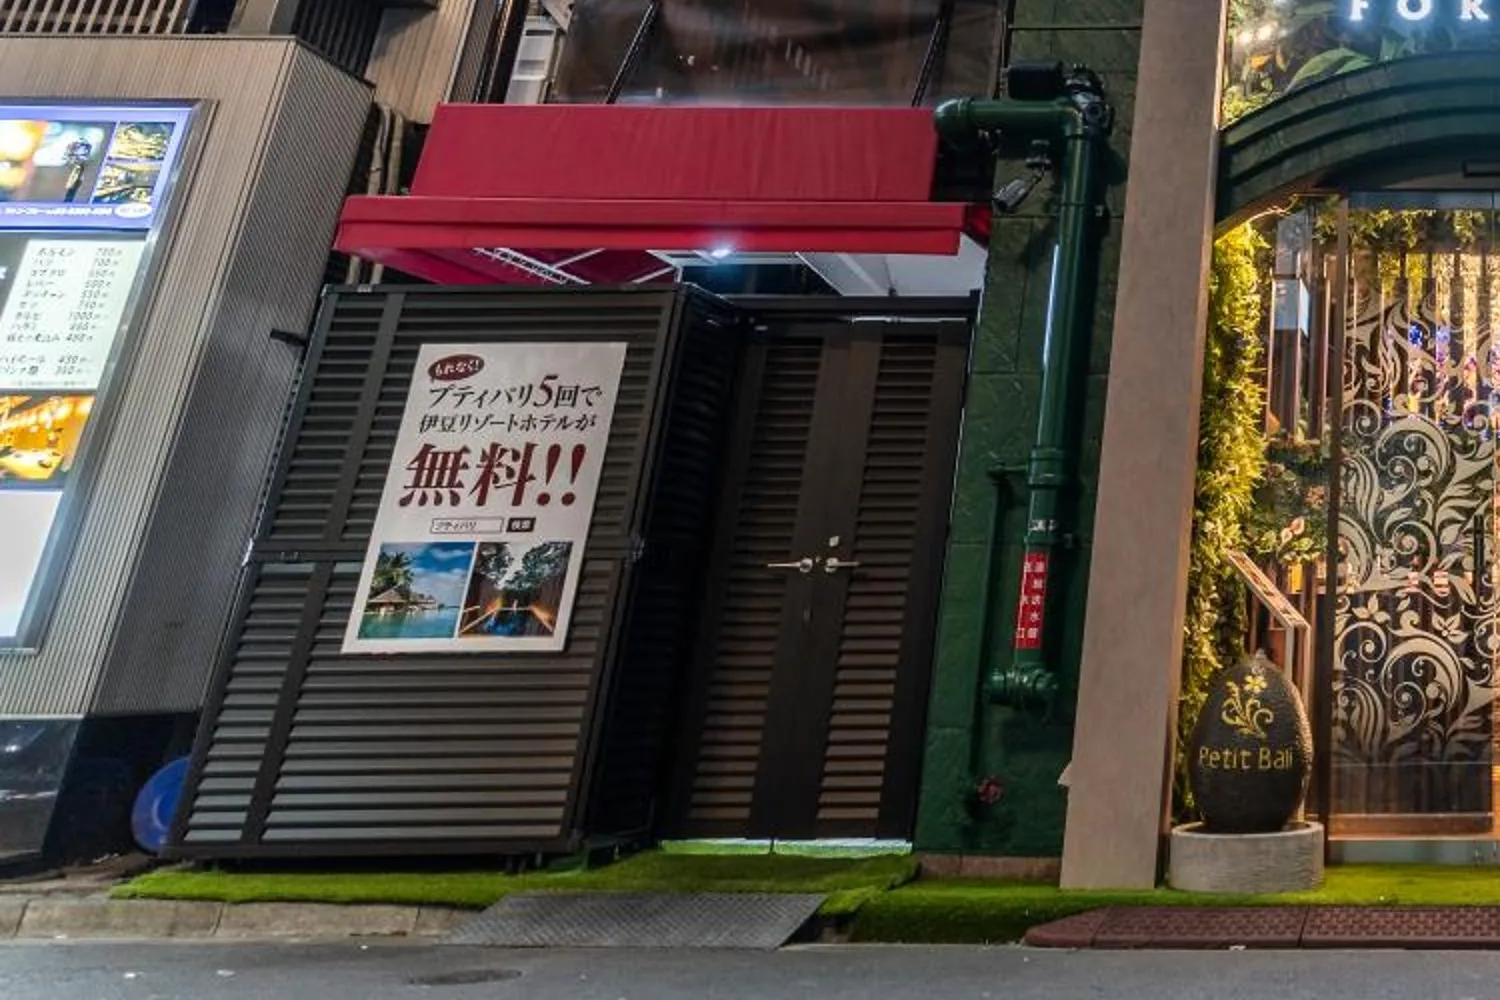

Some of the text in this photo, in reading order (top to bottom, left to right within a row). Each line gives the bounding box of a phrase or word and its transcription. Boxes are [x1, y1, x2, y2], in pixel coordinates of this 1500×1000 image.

[420, 412, 597, 433] 伊豆リゾートホテルが
[398, 442, 588, 508] 無料!!
[1198, 746, 1294, 770] Petit Bali
